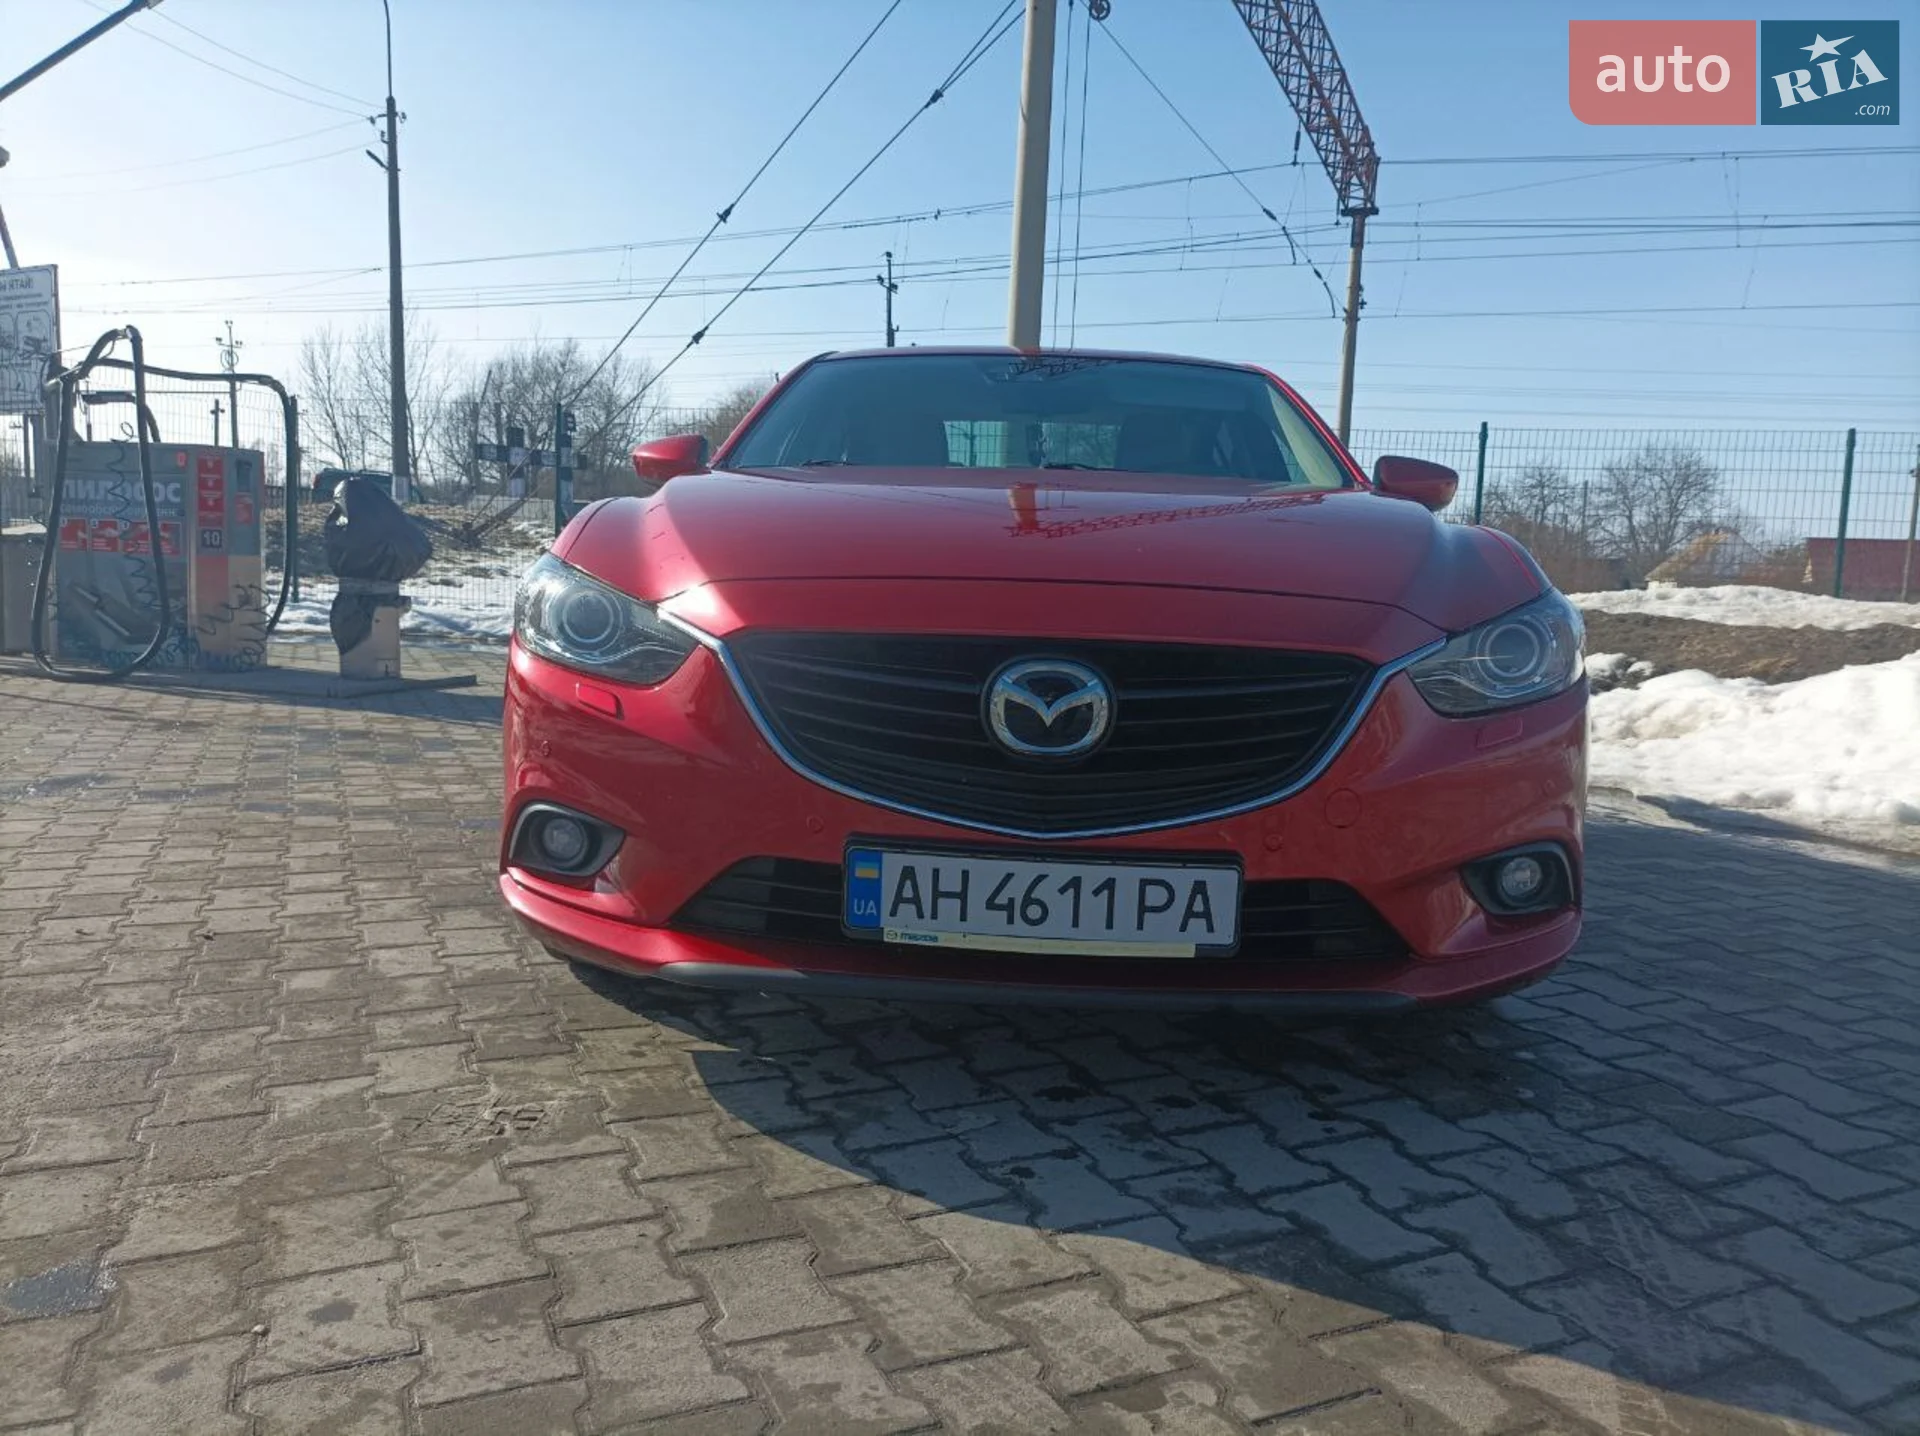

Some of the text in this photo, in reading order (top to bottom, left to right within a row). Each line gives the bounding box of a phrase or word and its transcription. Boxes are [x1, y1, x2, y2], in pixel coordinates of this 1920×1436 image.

[203, 531, 220, 546] 10
[853, 865, 1215, 933] UA AH 4611 PA
